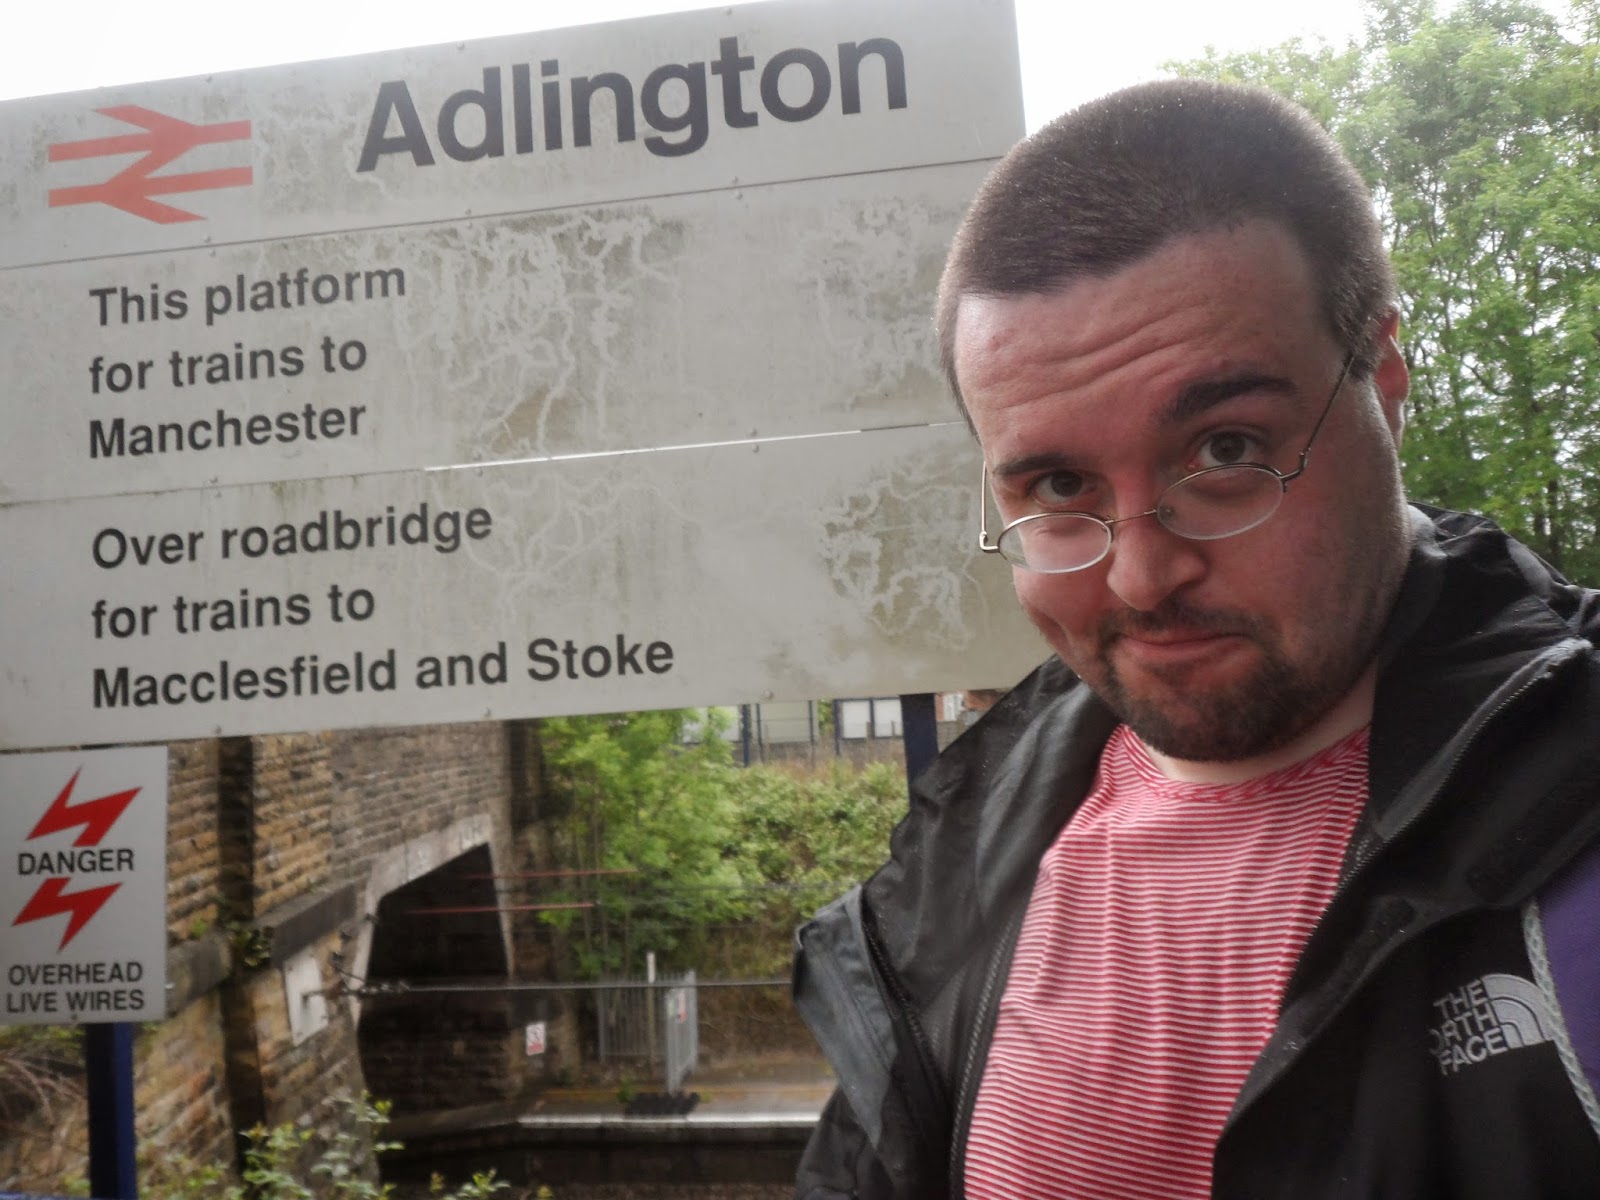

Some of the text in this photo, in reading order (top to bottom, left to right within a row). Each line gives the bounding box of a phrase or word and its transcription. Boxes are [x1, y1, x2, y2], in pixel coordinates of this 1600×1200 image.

[356, 36, 908, 172] Adlington
[89, 266, 406, 326] This platform
[89, 336, 367, 394] for trains to
[89, 403, 367, 459] Manchester
[92, 502, 493, 570] Over roadbridge
[91, 584, 375, 639] for trains to
[93, 634, 675, 709] Macclesfield and Stoke
[17, 848, 135, 876] DANGER
[6, 988, 144, 1013] LIVE WIRES
[8, 961, 143, 987] OVERHEAD
[1433, 979, 1488, 1020] THE
[1438, 1027, 1509, 1076] FACE
